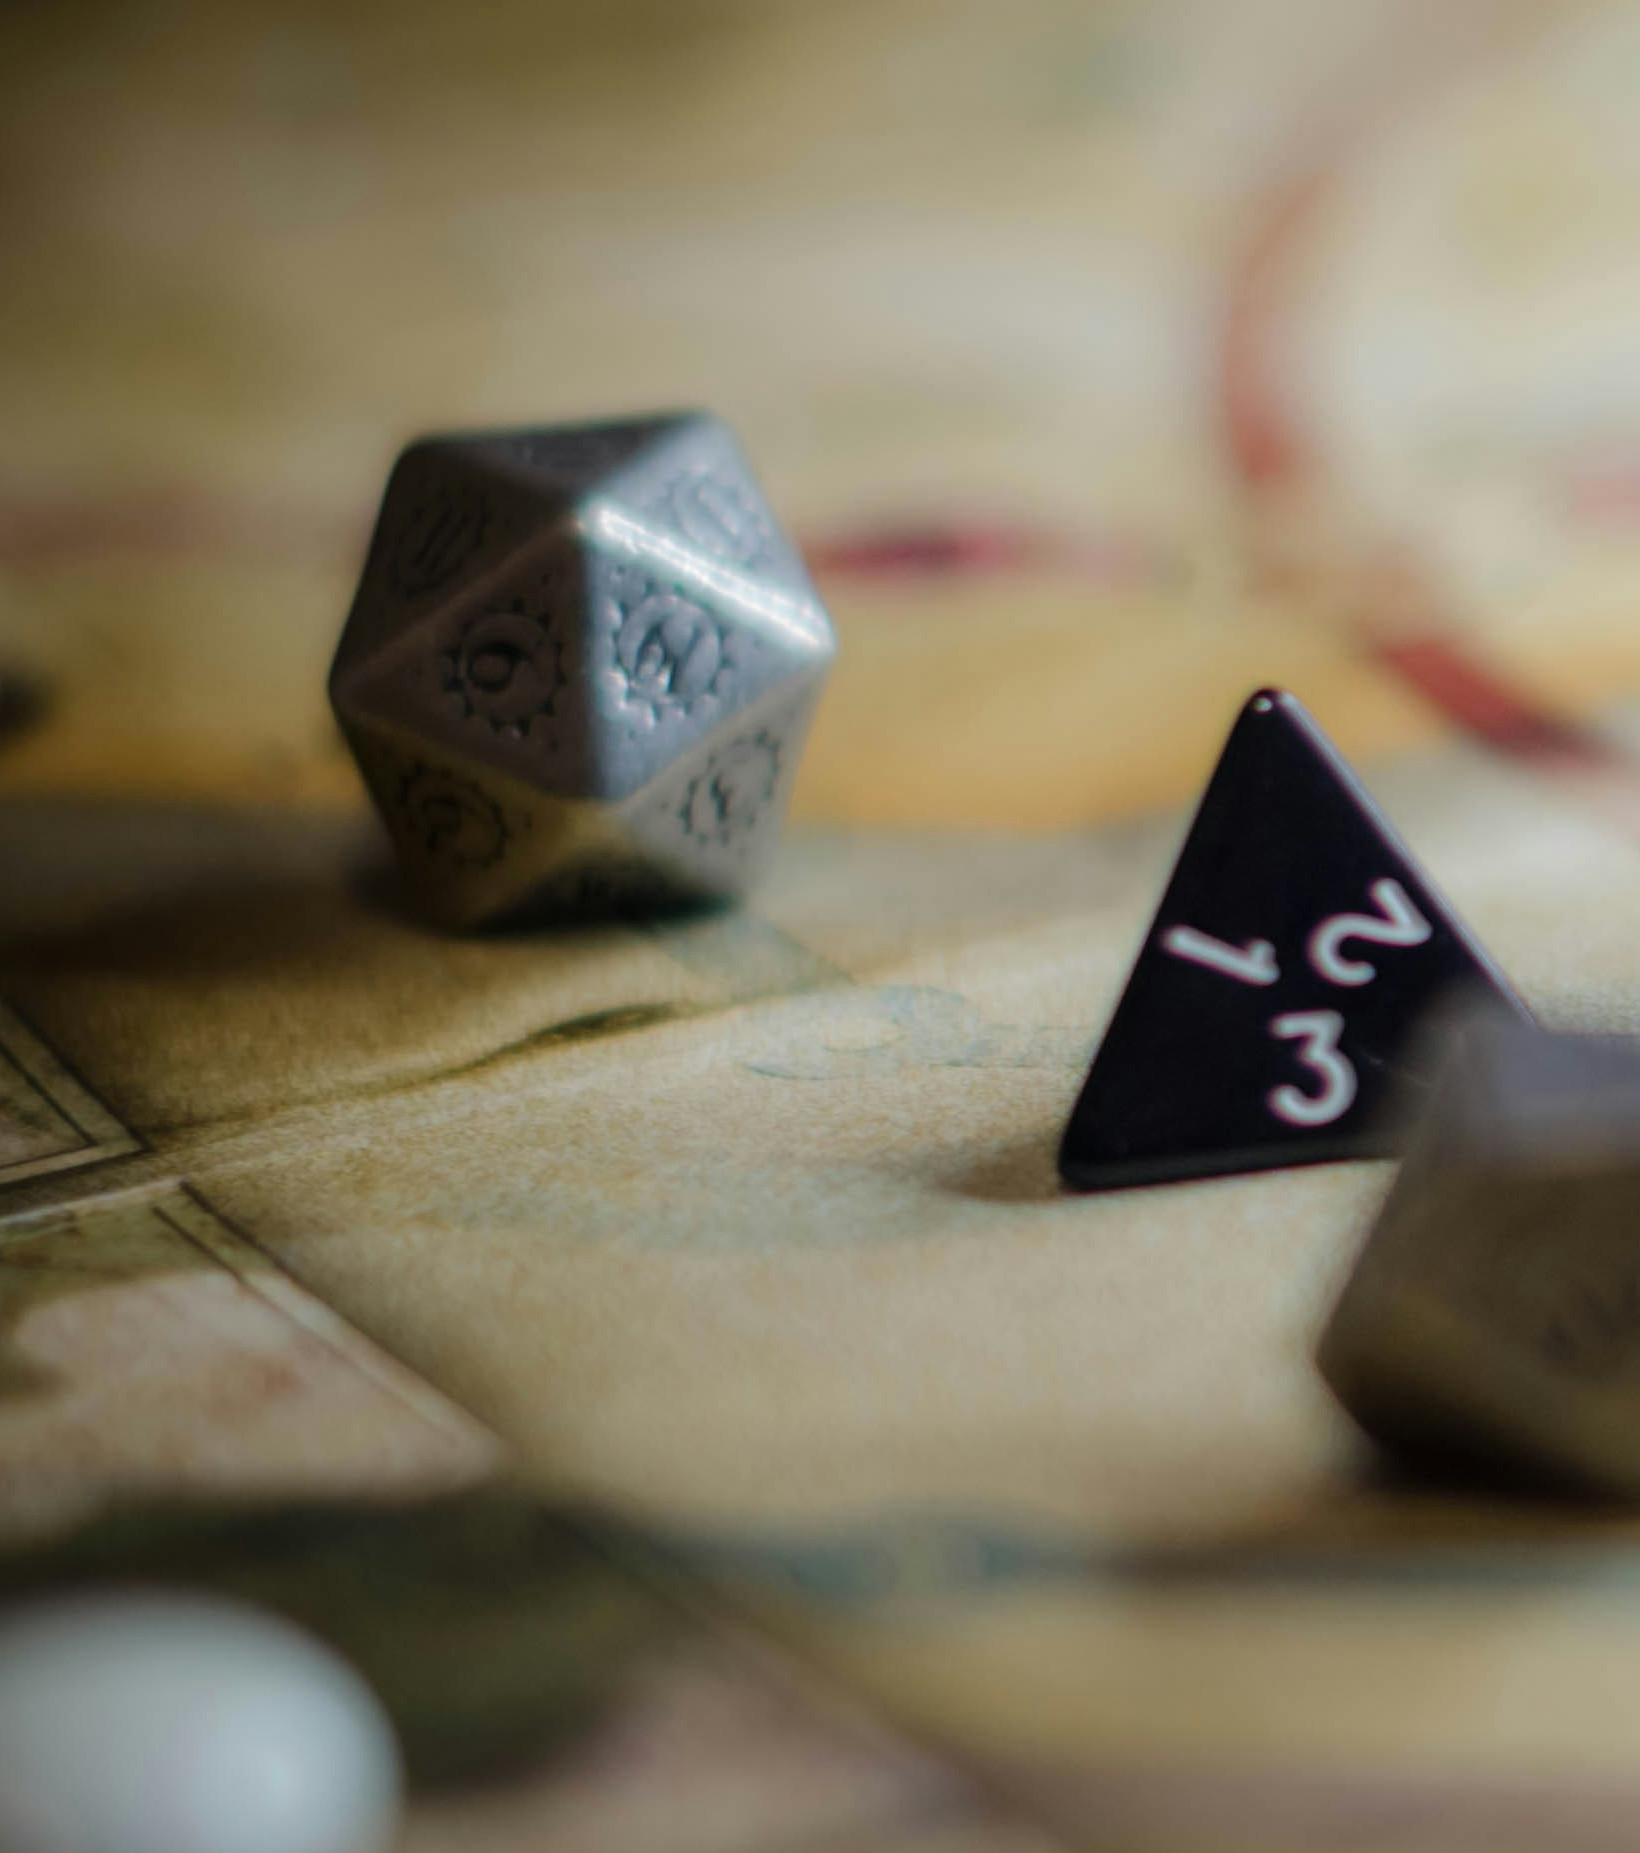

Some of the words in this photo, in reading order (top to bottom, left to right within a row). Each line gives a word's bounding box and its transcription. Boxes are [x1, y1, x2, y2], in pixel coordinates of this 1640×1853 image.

[1163, 922, 1280, 986] 1
[1310, 877, 1432, 987] 2
[1270, 1009, 1358, 1126] 3
